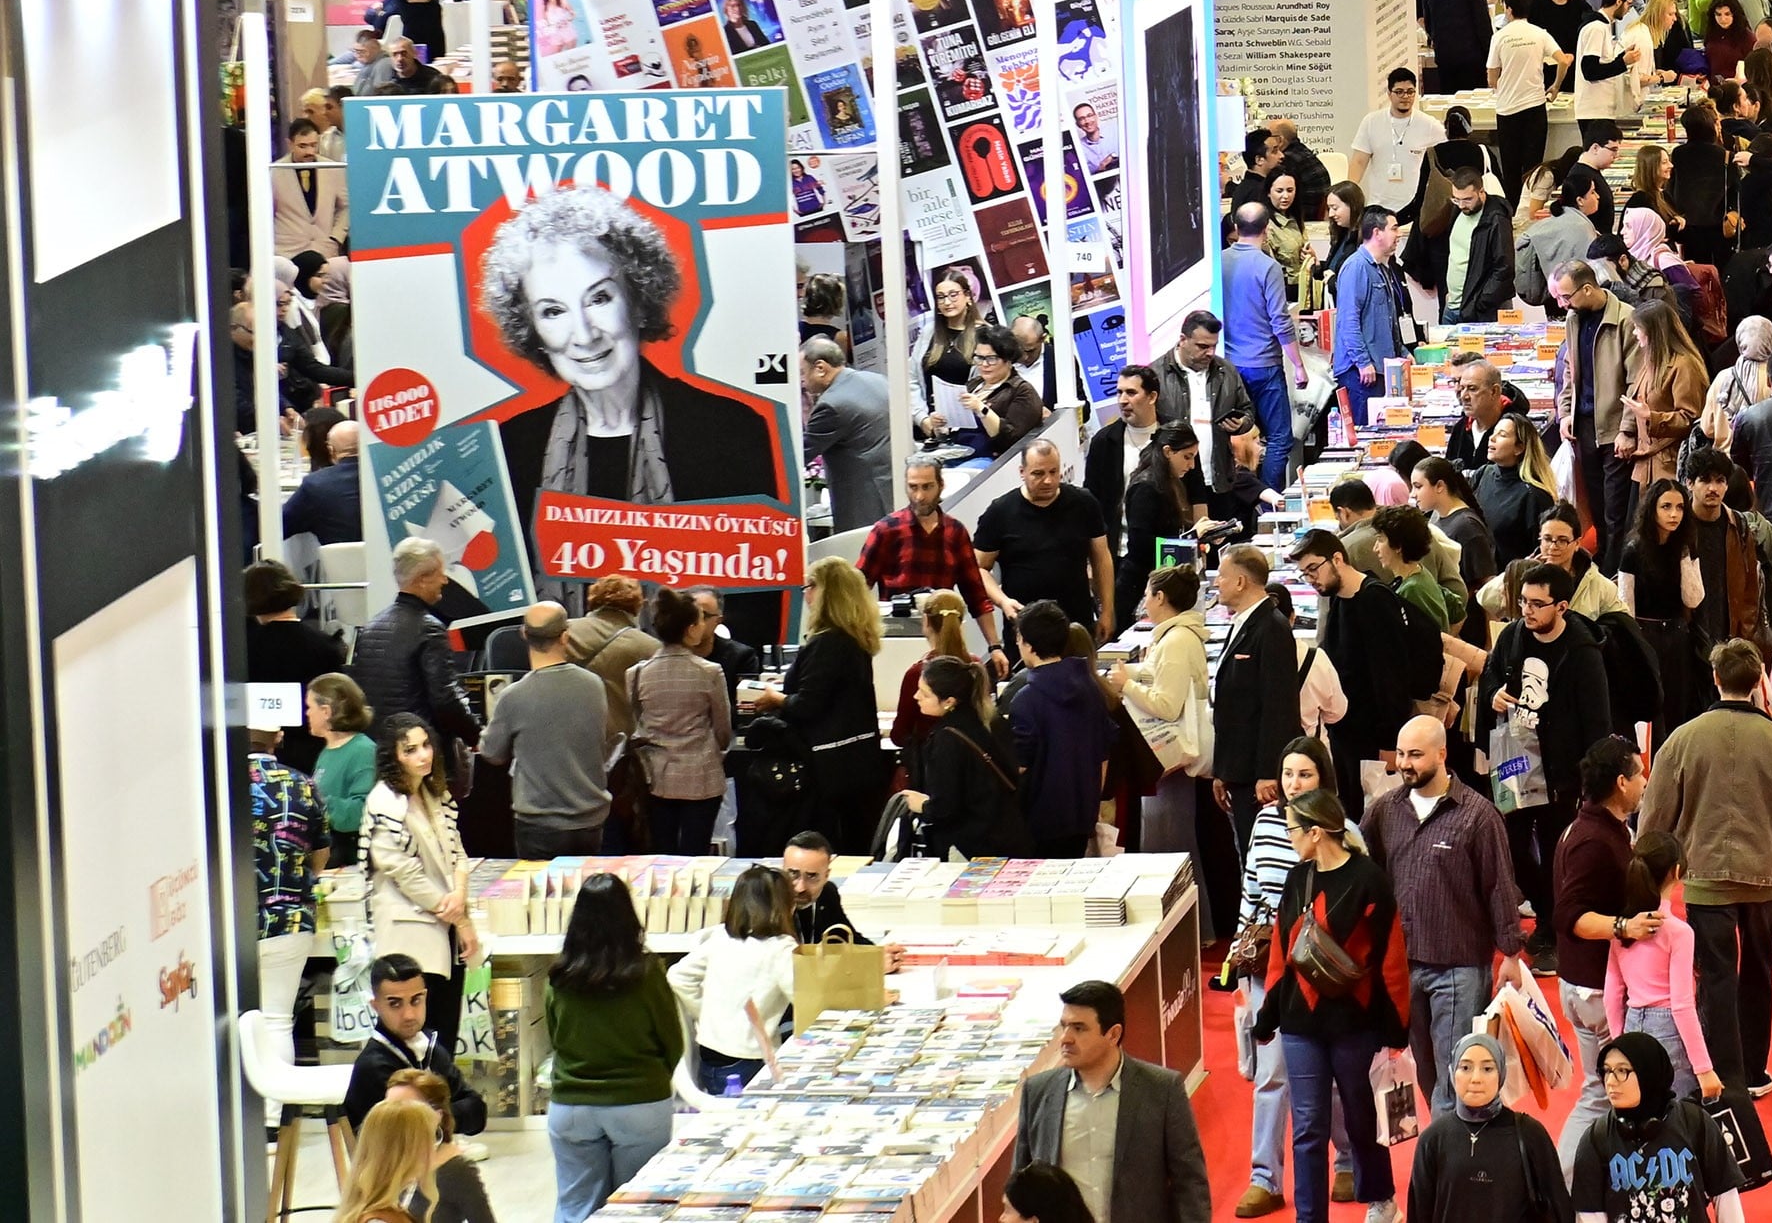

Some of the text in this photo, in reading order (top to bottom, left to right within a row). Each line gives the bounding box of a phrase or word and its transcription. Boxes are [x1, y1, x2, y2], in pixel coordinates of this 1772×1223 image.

[938, 32, 963, 48] TUNA
[1279, 51, 1331, 60] Shakespeare
[748, 66, 788, 86] Belki
[364, 94, 764, 152] MARGARET
[370, 148, 764, 216] ATWOOD
[907, 187, 932, 203] bir
[923, 197, 950, 213] aile
[916, 210, 953, 228] mese
[944, 224, 968, 238] lesi
[1076, 252, 1092, 261] 740
[374, 399, 434, 432] ADET
[545, 505, 800, 536] DAMIZLIK KIZIN ÖYKÜSÜ
[550, 539, 789, 587] 40 Yaşında!
[259, 697, 282, 710] 739
